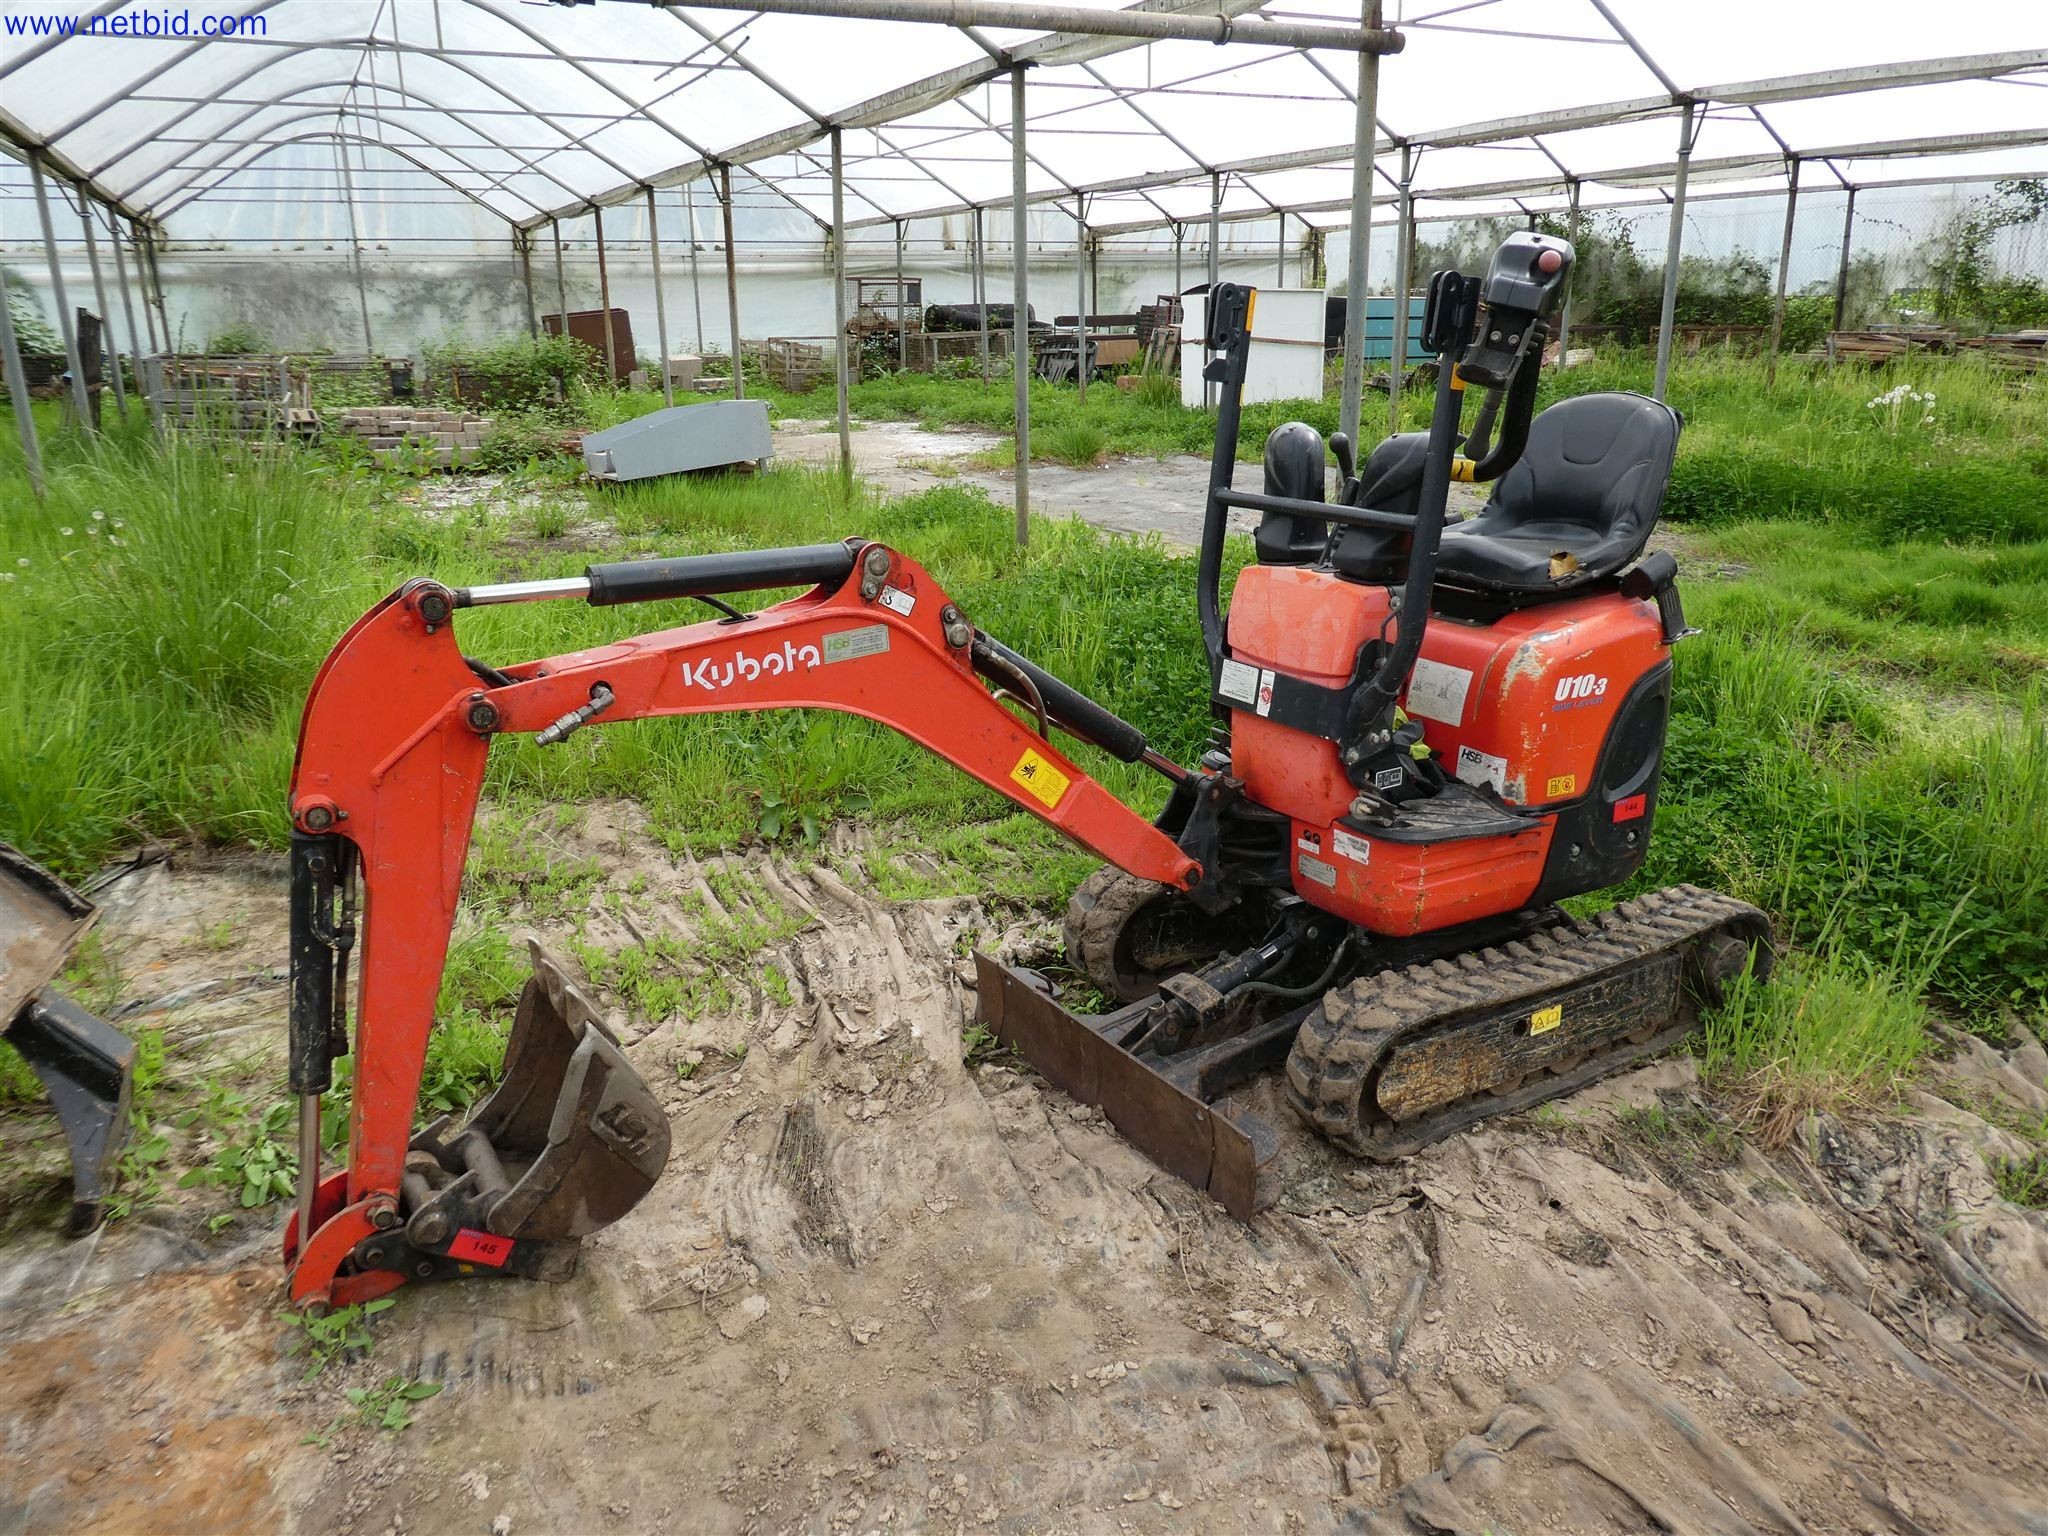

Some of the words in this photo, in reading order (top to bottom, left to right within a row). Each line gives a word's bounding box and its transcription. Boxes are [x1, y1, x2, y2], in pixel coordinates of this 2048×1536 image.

[682, 640, 821, 690] Kubota
[1554, 673, 1608, 702] U10-3
[472, 1241, 498, 1255] 145
